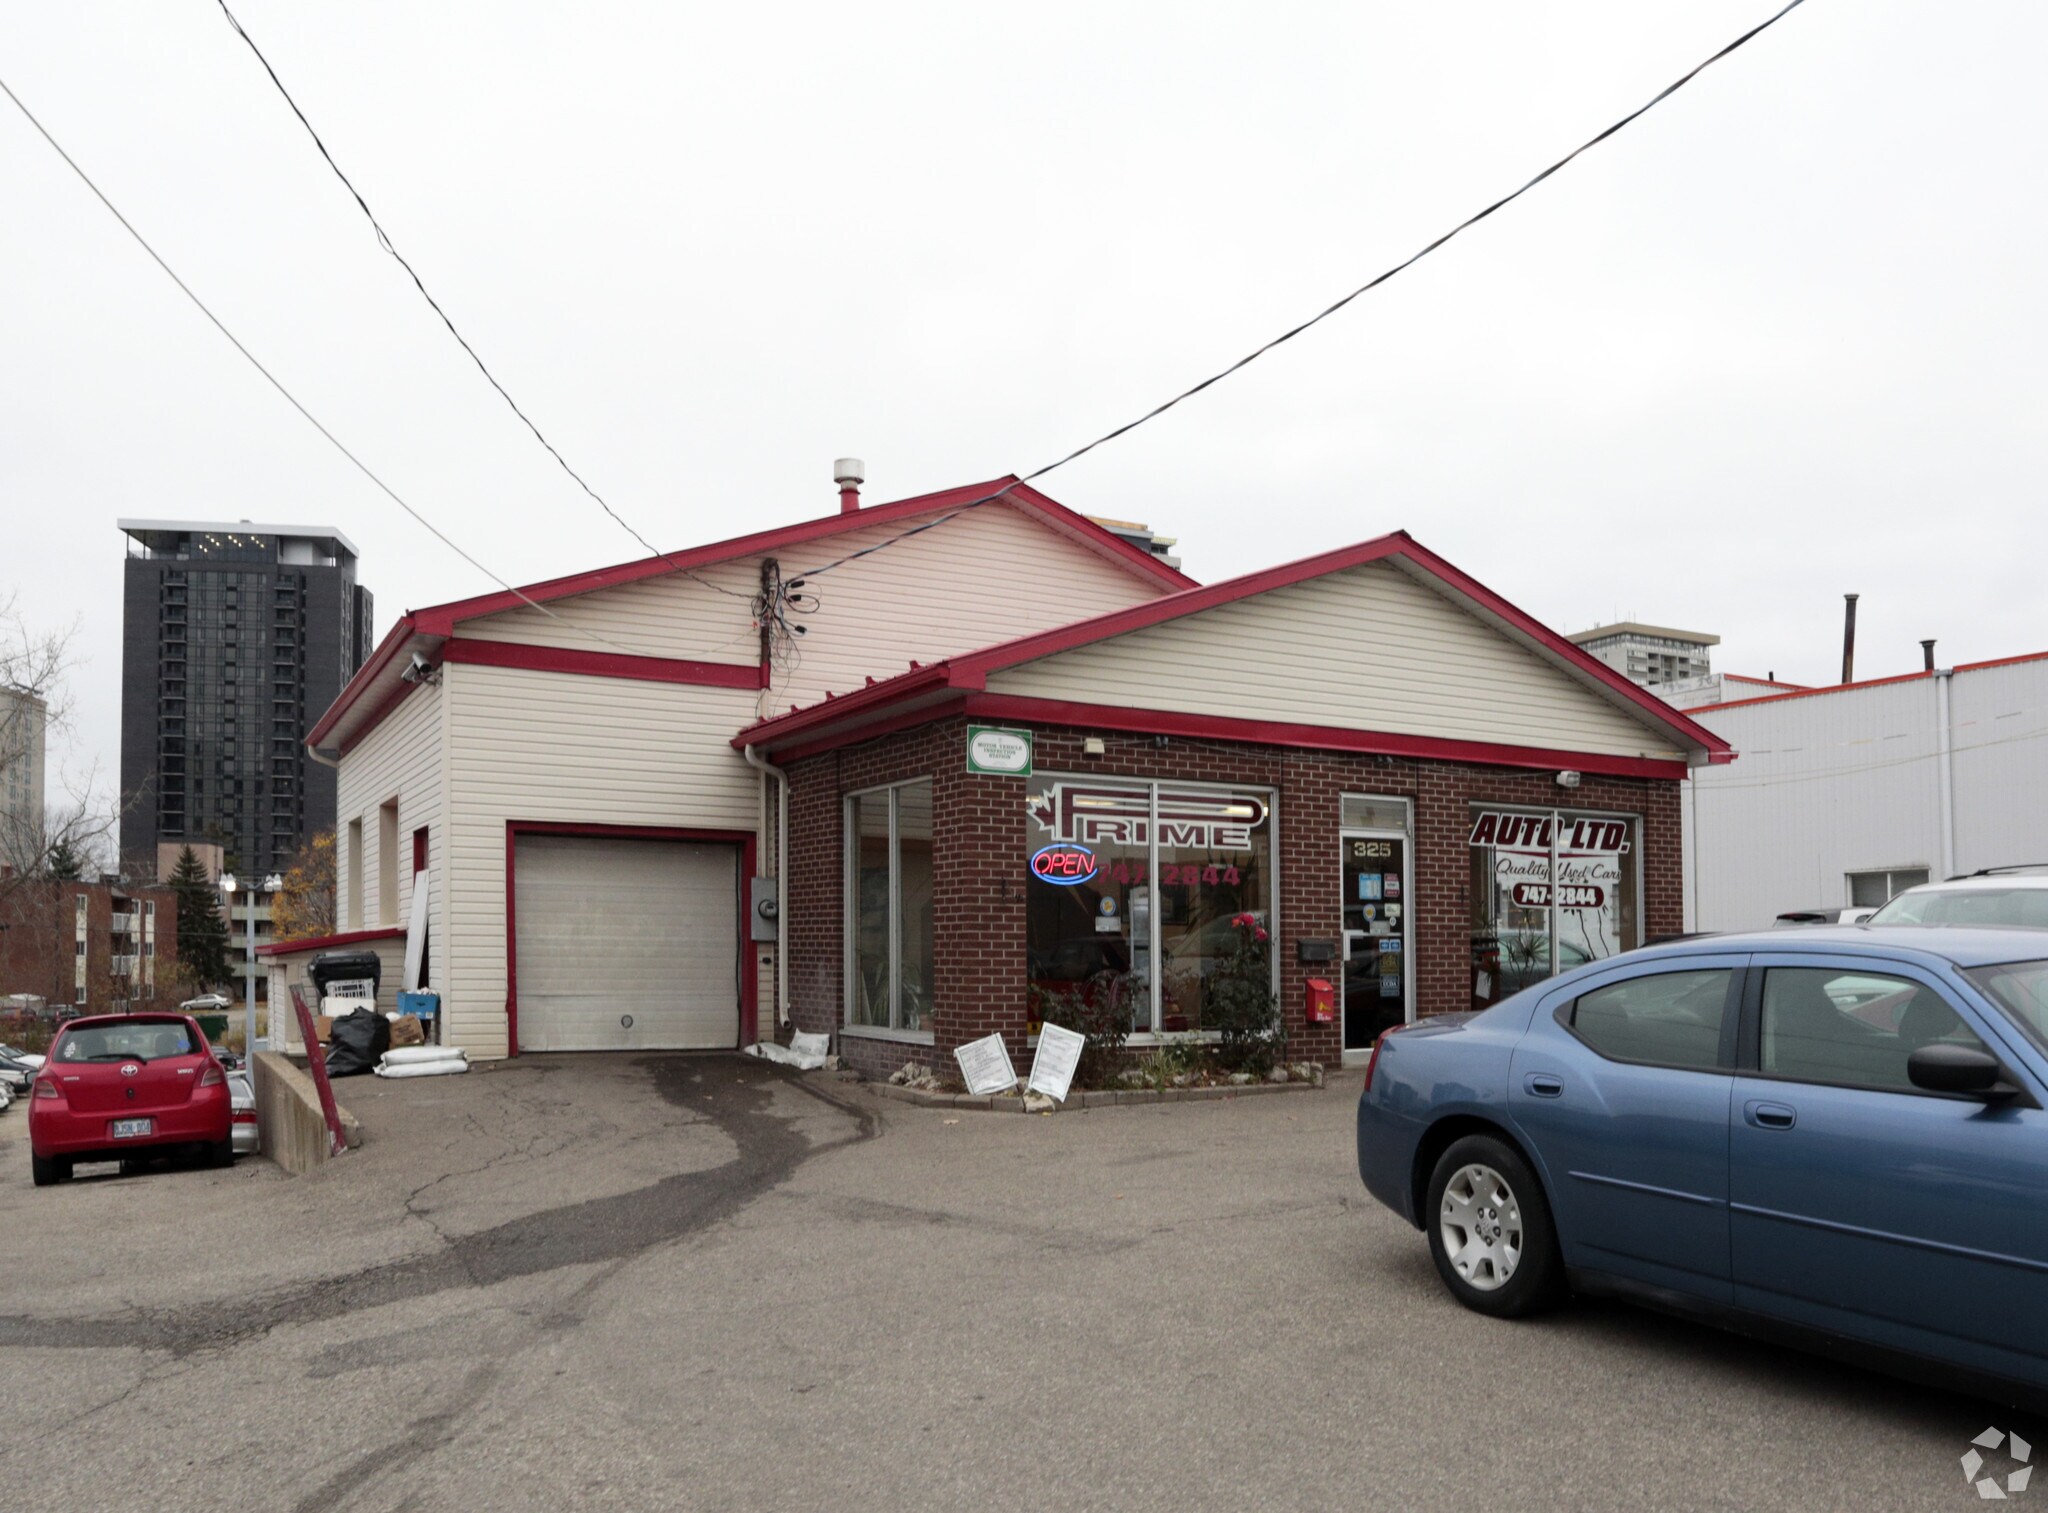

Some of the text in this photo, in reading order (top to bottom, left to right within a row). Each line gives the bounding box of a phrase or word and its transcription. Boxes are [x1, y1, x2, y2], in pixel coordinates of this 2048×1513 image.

[983, 748, 1016, 756] INSPECTION
[1050, 782, 1265, 850] PRIME
[1469, 812, 1631, 854] AUTO LTD.
[1353, 841, 1392, 857] 325
[1034, 852, 1096, 875] OPEN
[1495, 858, 1622, 880] Quality Used Cars
